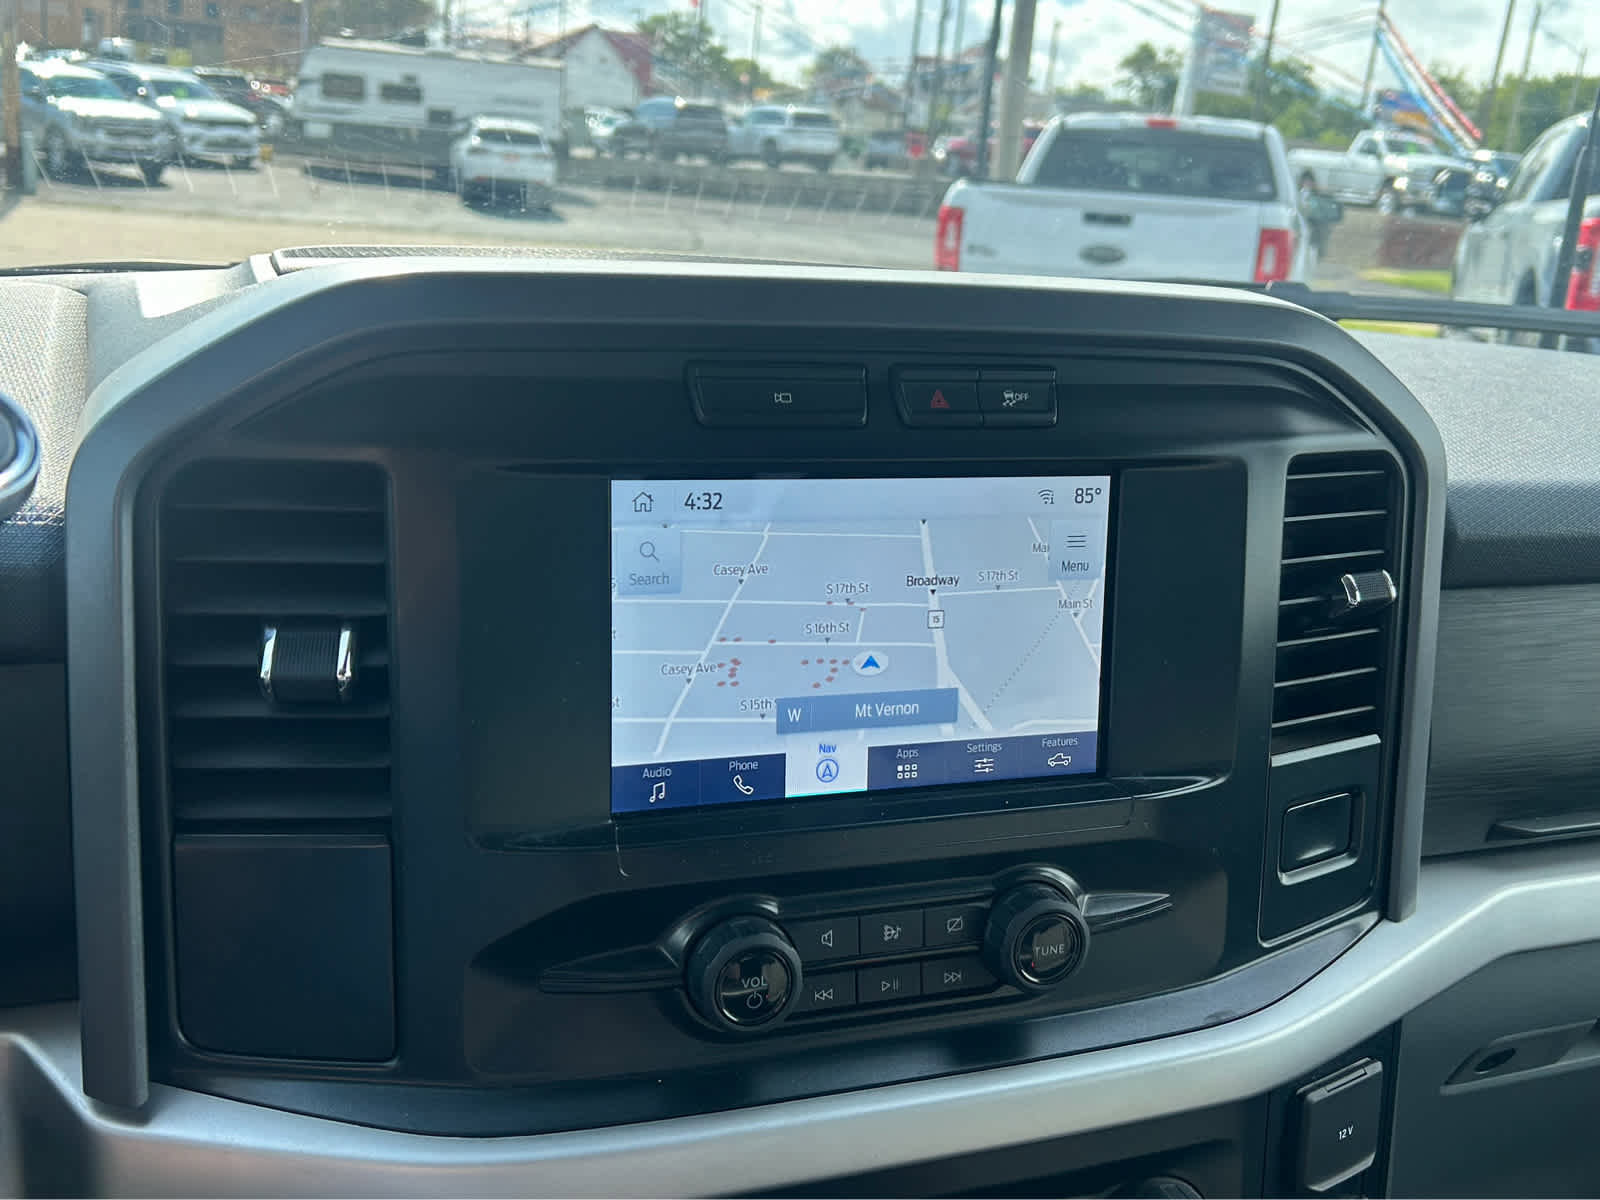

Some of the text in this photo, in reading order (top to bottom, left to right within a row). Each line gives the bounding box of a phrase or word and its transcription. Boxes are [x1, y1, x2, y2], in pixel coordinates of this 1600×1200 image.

[684, 492, 723, 510] 4:32
[1074, 487, 1102, 504] 85°
[713, 563, 769, 577] Casey Ave
[1061, 560, 1090, 572] Menu
[629, 572, 670, 586] Search
[906, 574, 960, 588] Broadway
[978, 570, 1019, 582] S 17th St
[826, 582, 869, 594] S 17th St
[1058, 599, 1093, 609] Main St
[805, 622, 850, 634] S 16th St
[661, 663, 717, 677] Casey Ave
[740, 701, 747, 712] S
[749, 699, 772, 711] 15th
[855, 703, 920, 718] Mt Vernon
[787, 708, 801, 722] W
[967, 742, 1002, 754] Settings
[1042, 736, 1079, 748] Features
[818, 743, 837, 754] Nav
[896, 749, 919, 760] Apps
[729, 759, 759, 771] Phone
[642, 767, 672, 779] Audio
[1035, 943, 1065, 959] TUNE
[741, 976, 768, 988] VOL
